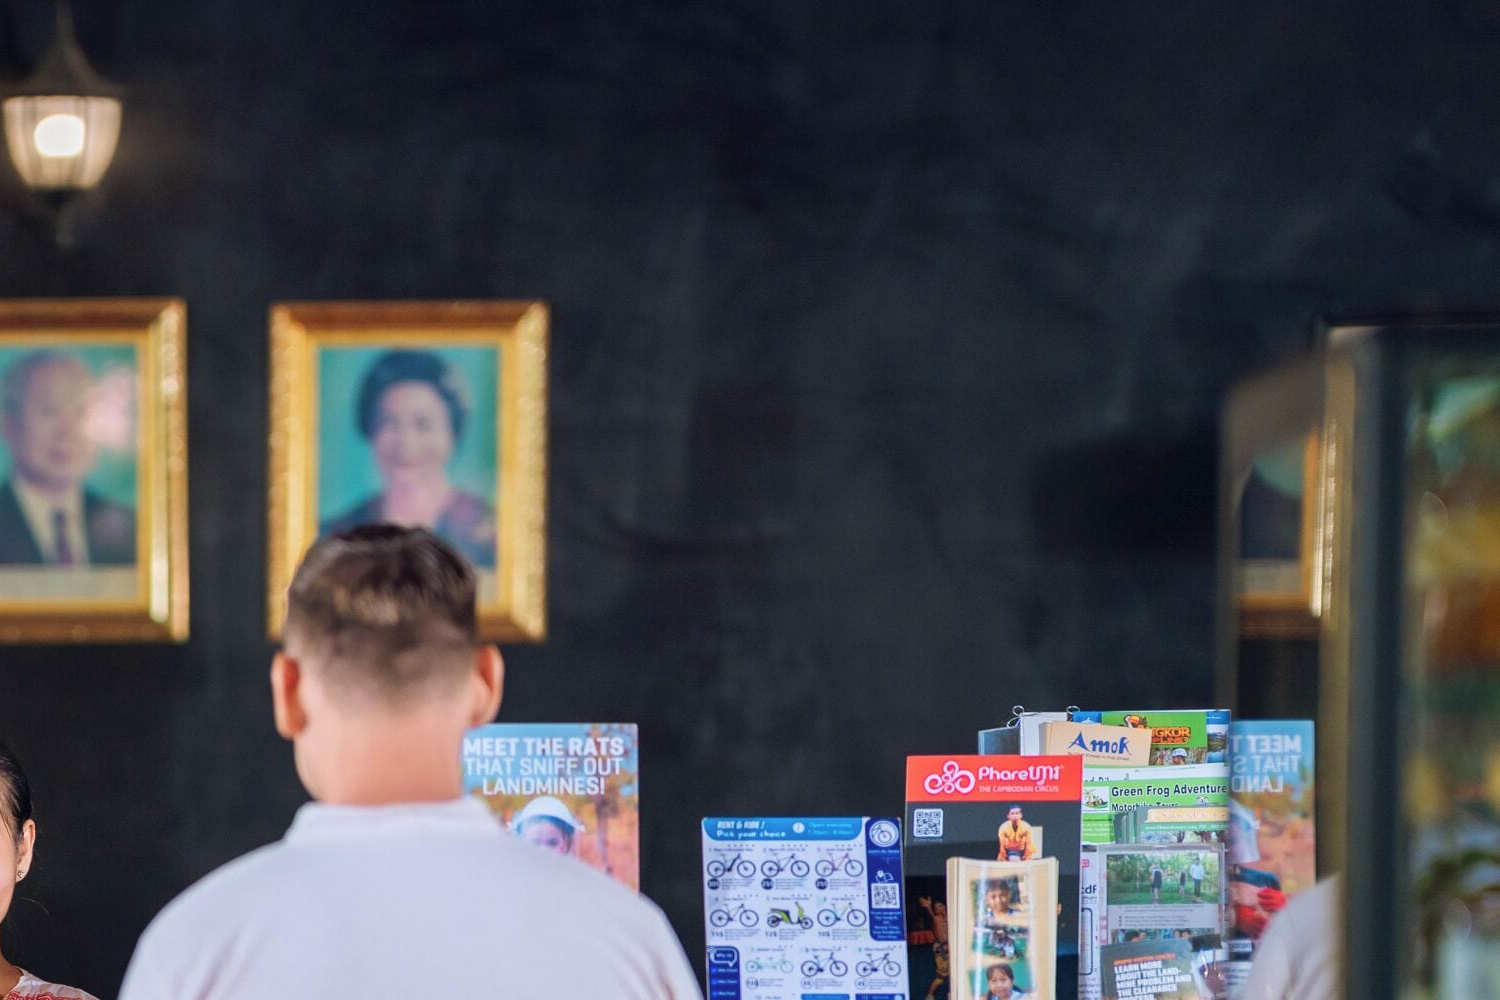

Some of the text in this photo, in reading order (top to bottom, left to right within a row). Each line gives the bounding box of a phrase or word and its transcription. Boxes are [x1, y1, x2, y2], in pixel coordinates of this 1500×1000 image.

[463, 737, 624, 756] MEET THE RATS
[1068, 731, 1132, 755] Amok
[464, 757, 624, 776] THAT SNIFF OUT
[978, 766, 1027, 781] Phare
[483, 777, 605, 796] LANDMINES!
[993, 785, 1033, 793] CAMBODIAN
[1034, 785, 1060, 793] CIRCUS
[1111, 784, 1228, 797] Green Frog Adventure
[1114, 963, 1140, 974] LEARN
[1140, 960, 1163, 970] MORE
[1115, 967, 1182, 981] ABOUT THE LAND-
[1116, 974, 1192, 990] MINE PROBLEM AND
[1117, 983, 1178, 998] THE CLEARANCE
